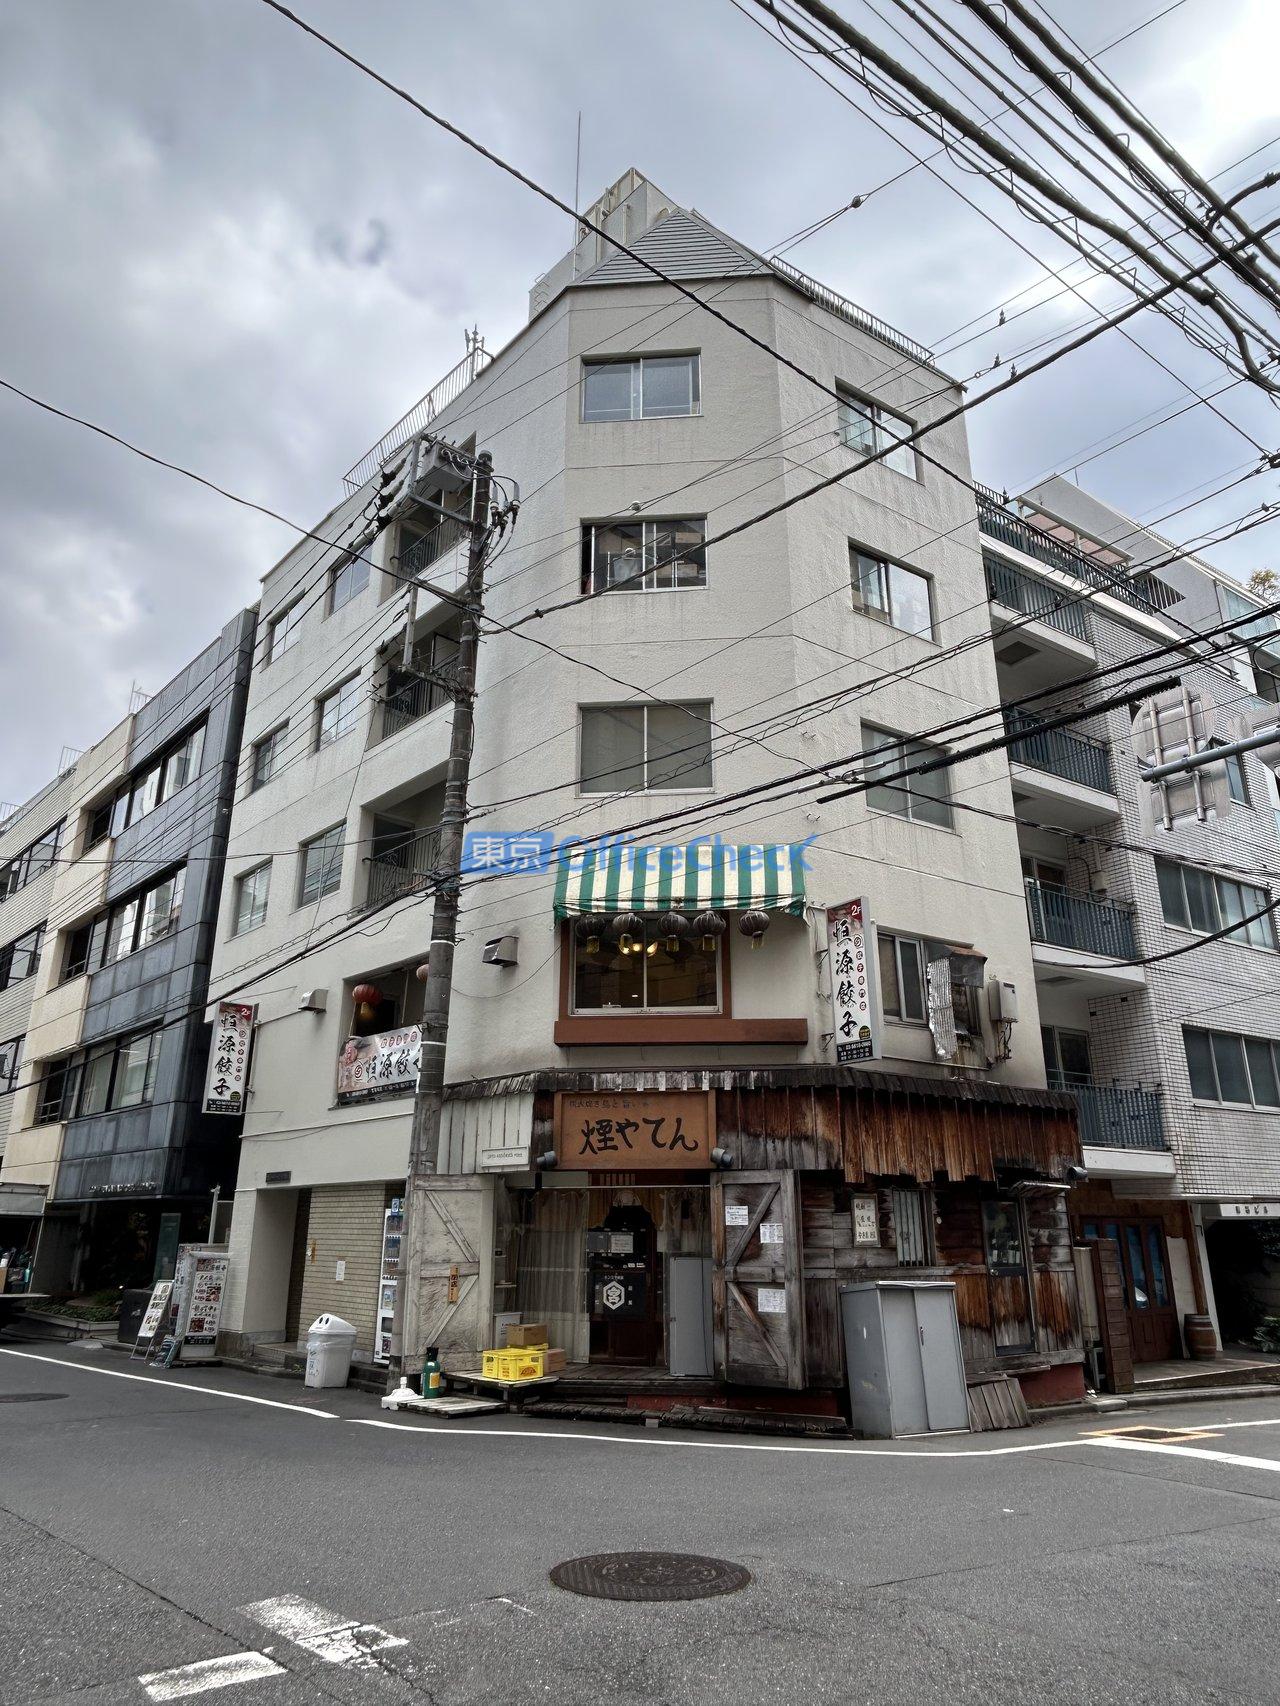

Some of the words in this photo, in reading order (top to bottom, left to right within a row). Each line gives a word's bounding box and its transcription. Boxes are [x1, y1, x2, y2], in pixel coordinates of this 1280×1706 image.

[851, 905, 862, 916] 2F
[833, 918, 858, 1038] 恒源餃子
[213, 1012, 238, 1097] 恒源餃子
[365, 1048, 421, 1083] 恒源餃
[578, 1117, 699, 1155] 煙やてん
